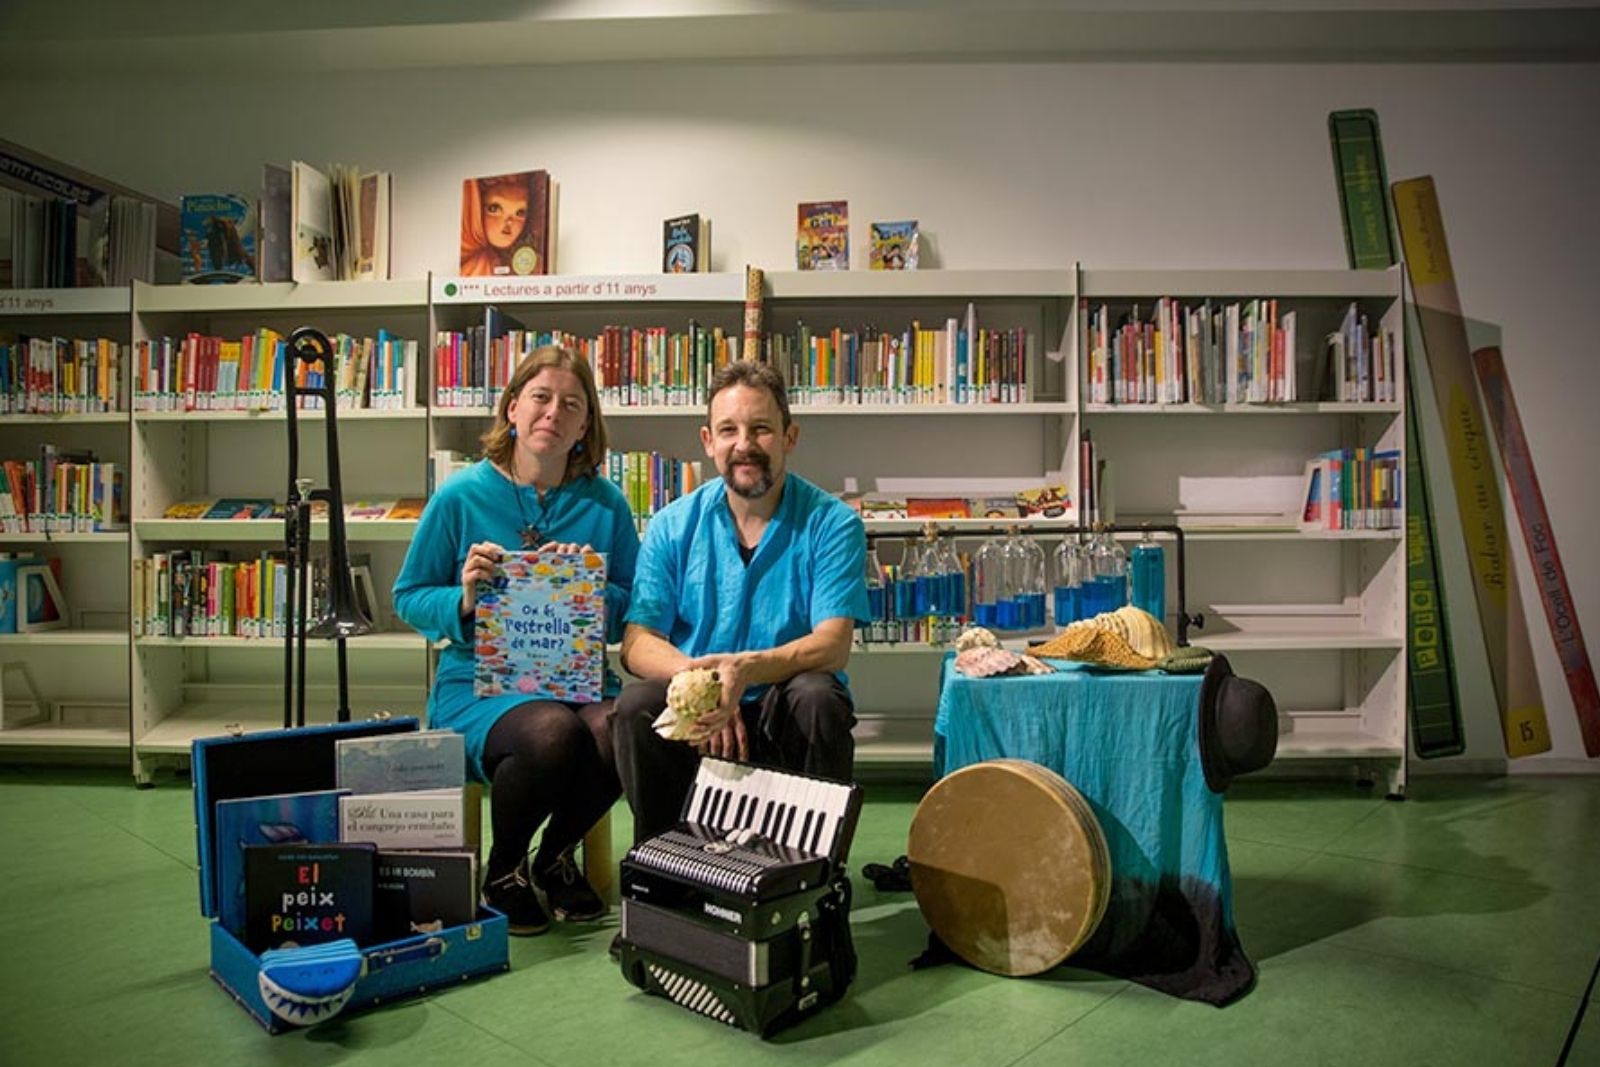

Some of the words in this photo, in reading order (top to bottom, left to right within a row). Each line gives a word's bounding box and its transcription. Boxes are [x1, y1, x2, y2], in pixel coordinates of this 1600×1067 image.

[484, 283, 540, 296] Lectures
[543, 285, 552, 295] a
[556, 281, 589, 298] partir
[593, 281, 620, 295] d'11
[624, 284, 657, 298] anys
[25, 298, 54, 311] anys
[1532, 522, 1551, 554] Foc
[505, 617, 571, 635] l'estrella
[511, 637, 525, 649] de
[530, 637, 565, 651] mar?
[380, 807, 402, 819] Una
[404, 810, 428, 819] casa
[431, 809, 455, 821] para
[347, 821, 357, 832] el
[360, 822, 406, 834] cangrejo
[298, 862, 320, 885] El
[282, 886, 334, 913] peix
[704, 902, 742, 924] HOHNER
